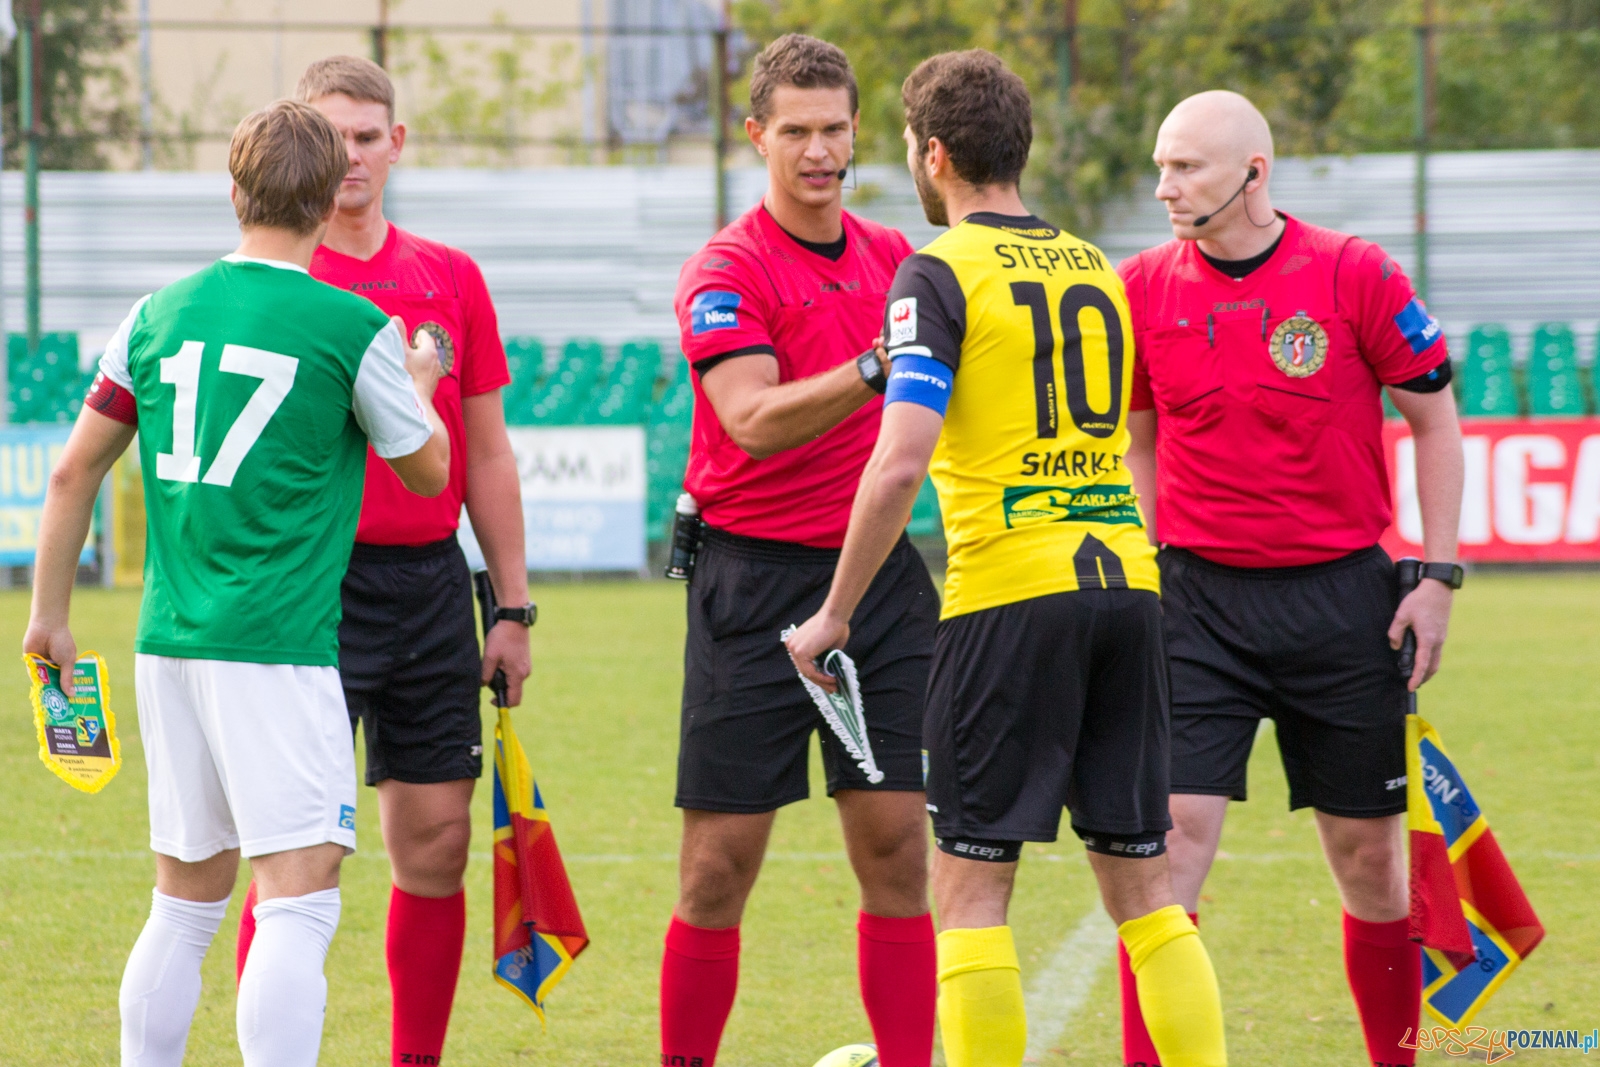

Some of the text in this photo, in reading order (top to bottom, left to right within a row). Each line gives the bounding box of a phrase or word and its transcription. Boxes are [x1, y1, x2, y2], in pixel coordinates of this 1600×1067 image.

[995, 244, 1104, 276] STĘPIEŃ
[705, 311, 736, 325] Nice
[1009, 281, 1124, 438] 10
[155, 340, 299, 487] 17
[969, 844, 1004, 859] cep
[1125, 842, 1158, 855] cep
